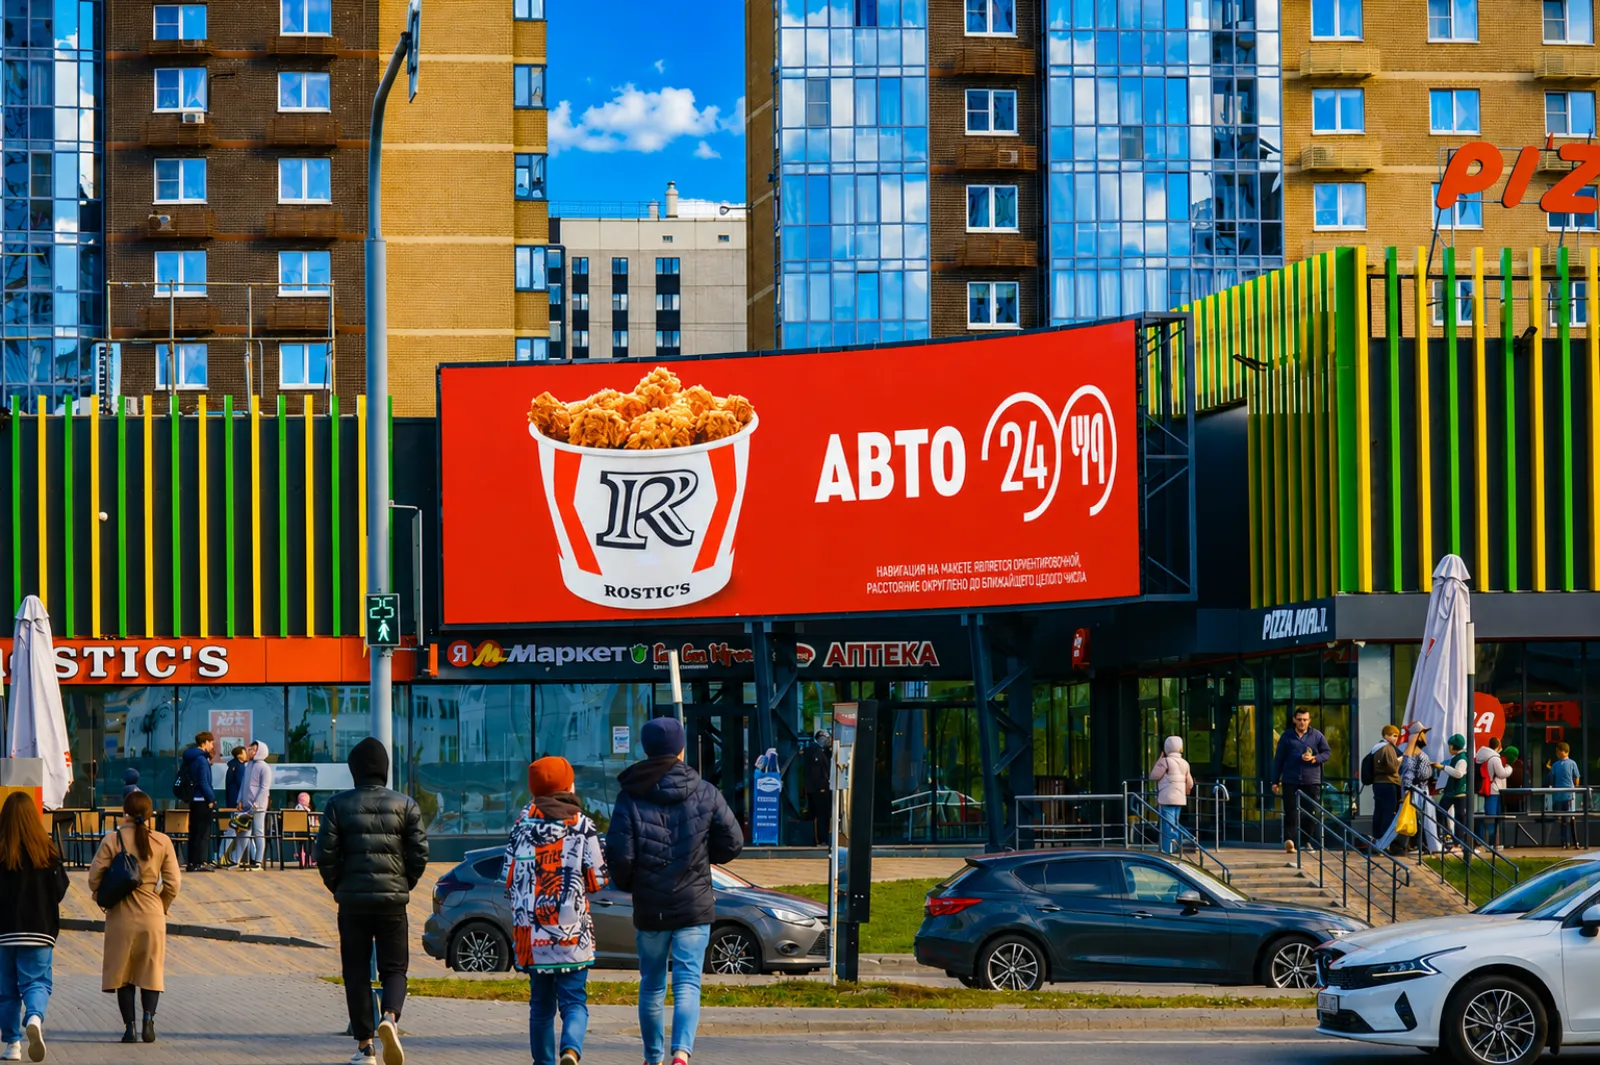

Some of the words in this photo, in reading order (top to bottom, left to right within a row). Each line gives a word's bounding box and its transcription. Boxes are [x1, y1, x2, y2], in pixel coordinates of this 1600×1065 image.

[814, 425, 966, 503] АВТО
[1000, 420, 1048, 492] 24
[876, 564, 926, 577] НАВИГАЦИЯ
[927, 563, 940, 575] НА
[941, 561, 972, 574] МАКЕТЕ
[974, 559, 1012, 573] ЯВЛЯЕТСЯ
[603, 582, 691, 599] ROSTIC'S
[866, 580, 920, 594] РАССТОЯНИЕ
[921, 578, 968, 592] ОКРУГЛЕНО
[969, 577, 981, 591] ДО
[1035, 572, 1063, 587] ЦЕЛОГО
[1063, 571, 1088, 584] ЧИСЛА
[0, 645, 230, 679] STIC'S
[452, 644, 467, 662] Я
[507, 644, 628, 666] Маркет
[822, 640, 940, 668] АПТЕКА
